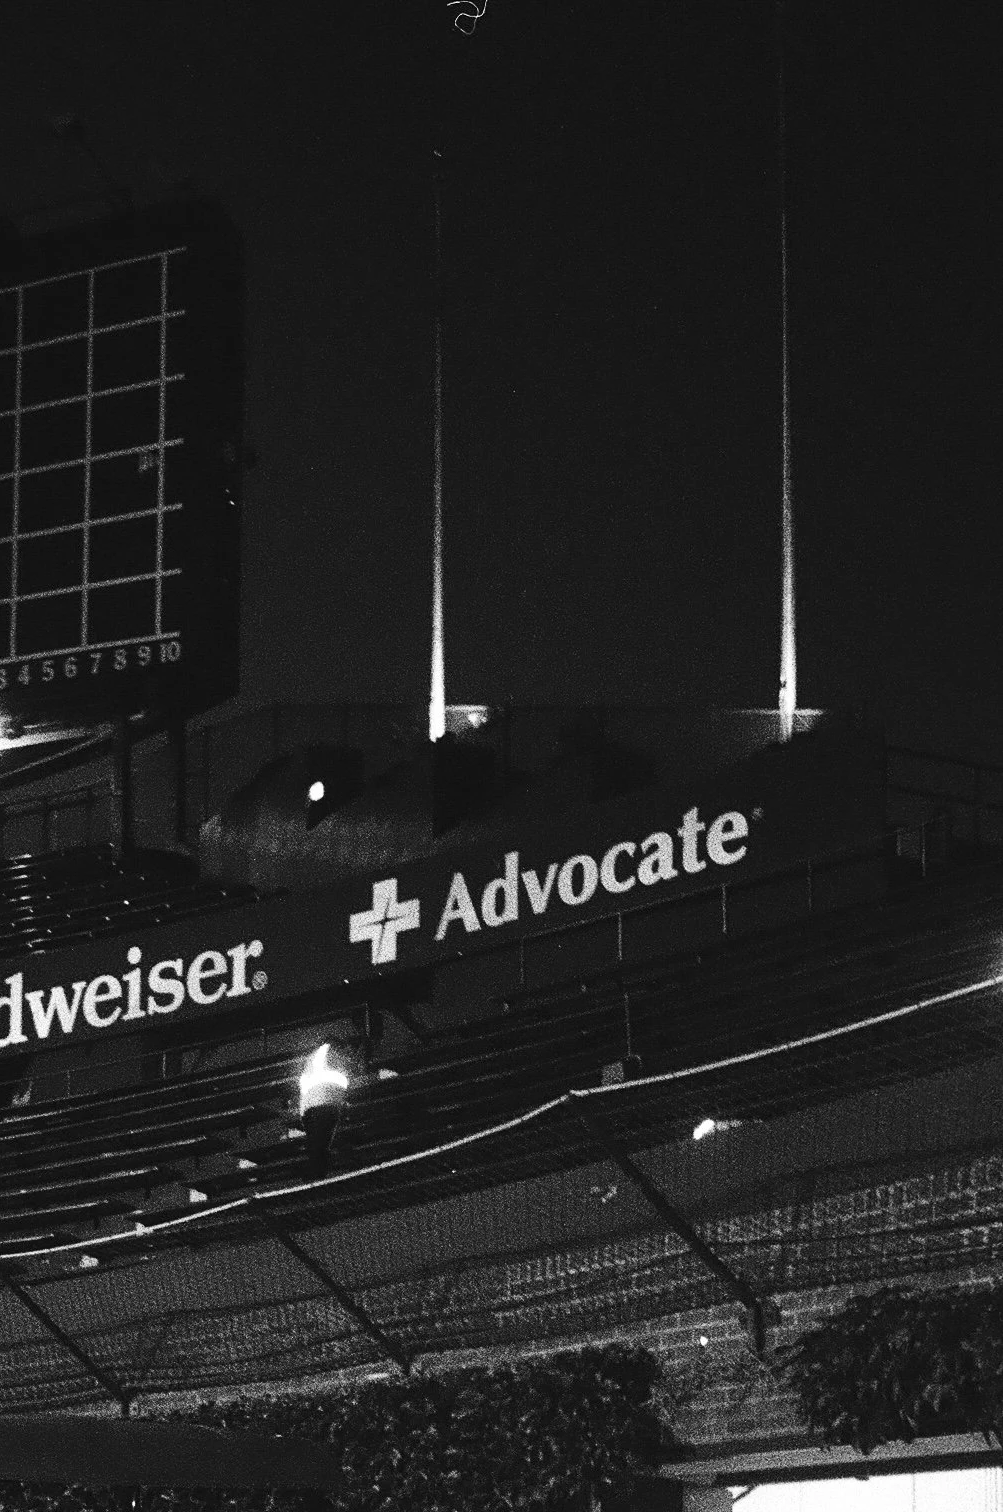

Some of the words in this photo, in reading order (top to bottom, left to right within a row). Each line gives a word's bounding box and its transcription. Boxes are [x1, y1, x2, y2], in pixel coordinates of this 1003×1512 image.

[17, 665, 31, 685] 4
[42, 659, 54, 682] 5
[64, 656, 77, 678] 6
[90, 652, 102, 674] 7
[113, 649, 127, 671] 8
[137, 645, 151, 666] 9
[159, 641, 181, 663] 10
[434, 806, 749, 941] Advocate
